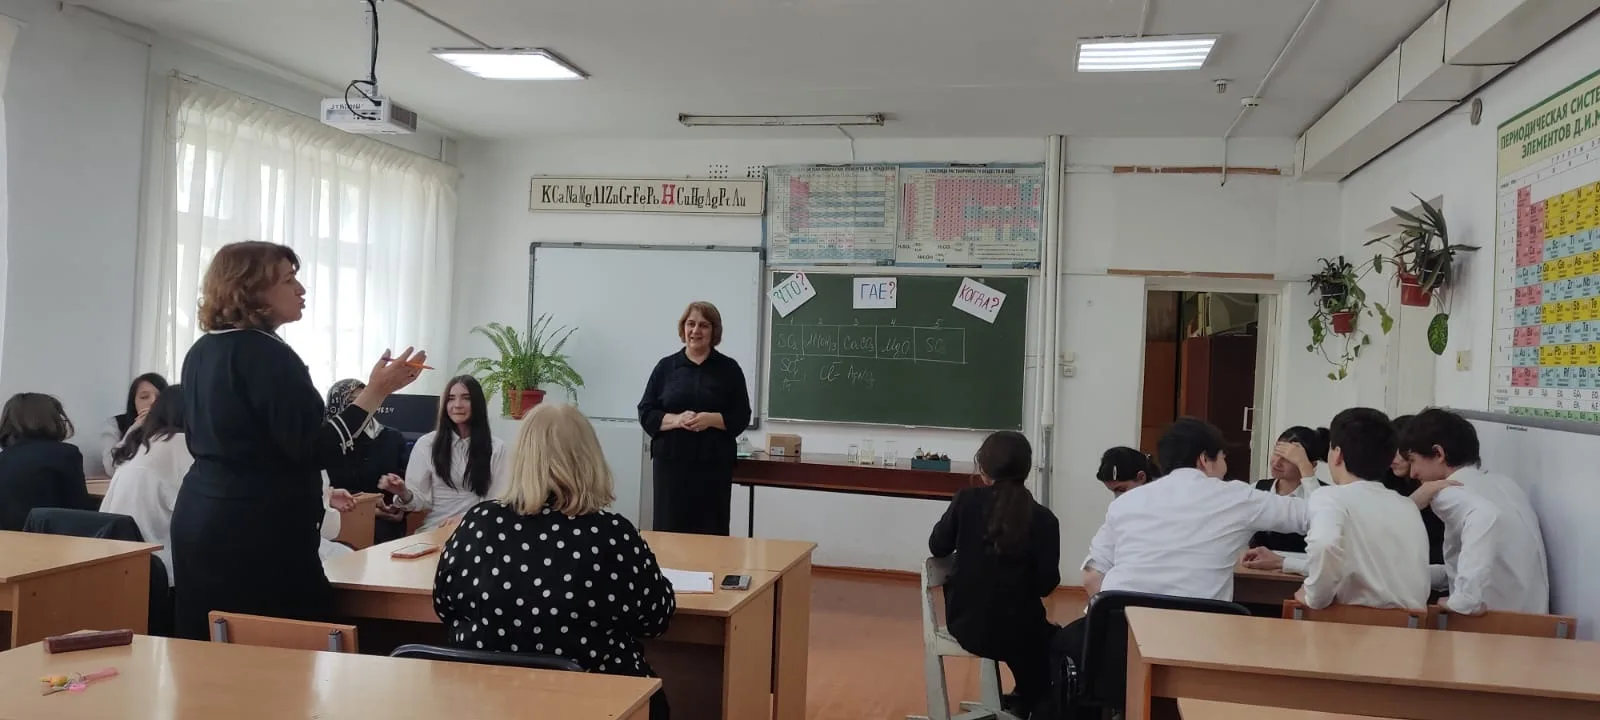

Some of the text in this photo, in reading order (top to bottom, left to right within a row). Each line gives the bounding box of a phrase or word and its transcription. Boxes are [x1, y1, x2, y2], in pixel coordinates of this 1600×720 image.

[1500, 102, 1568, 150] ПЕРИОДИЧЕСКАЯ
[1521, 123, 1571, 159] ЭЛЕМЕНТОВ
[773, 272, 807, 303] ЧТО?
